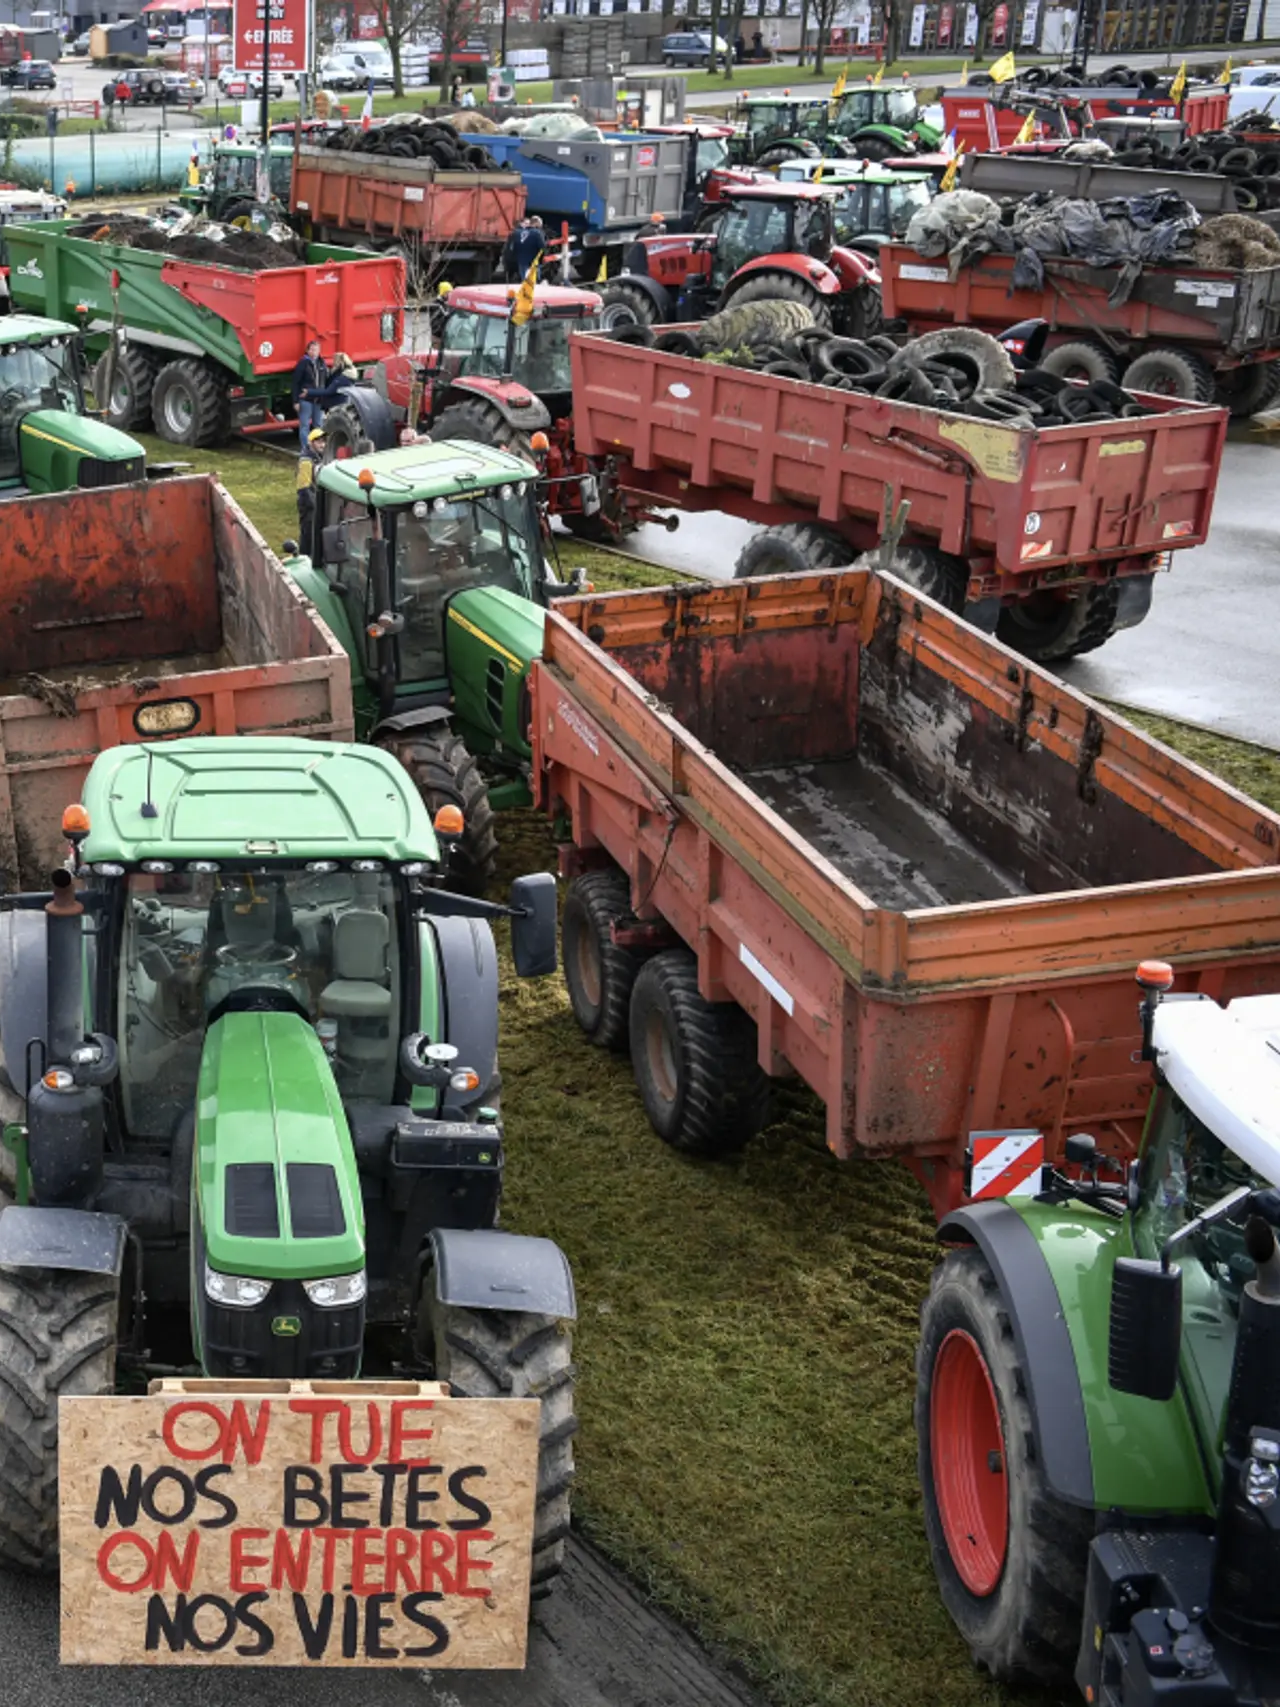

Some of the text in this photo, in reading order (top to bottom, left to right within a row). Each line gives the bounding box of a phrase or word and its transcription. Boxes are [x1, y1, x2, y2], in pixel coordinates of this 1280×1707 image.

[162, 1399, 435, 1471] ON TUE
[94, 1463, 492, 1531] NOS BETES
[97, 1527, 495, 1598] ON ENTERRE
[145, 1591, 275, 1657] NOS
